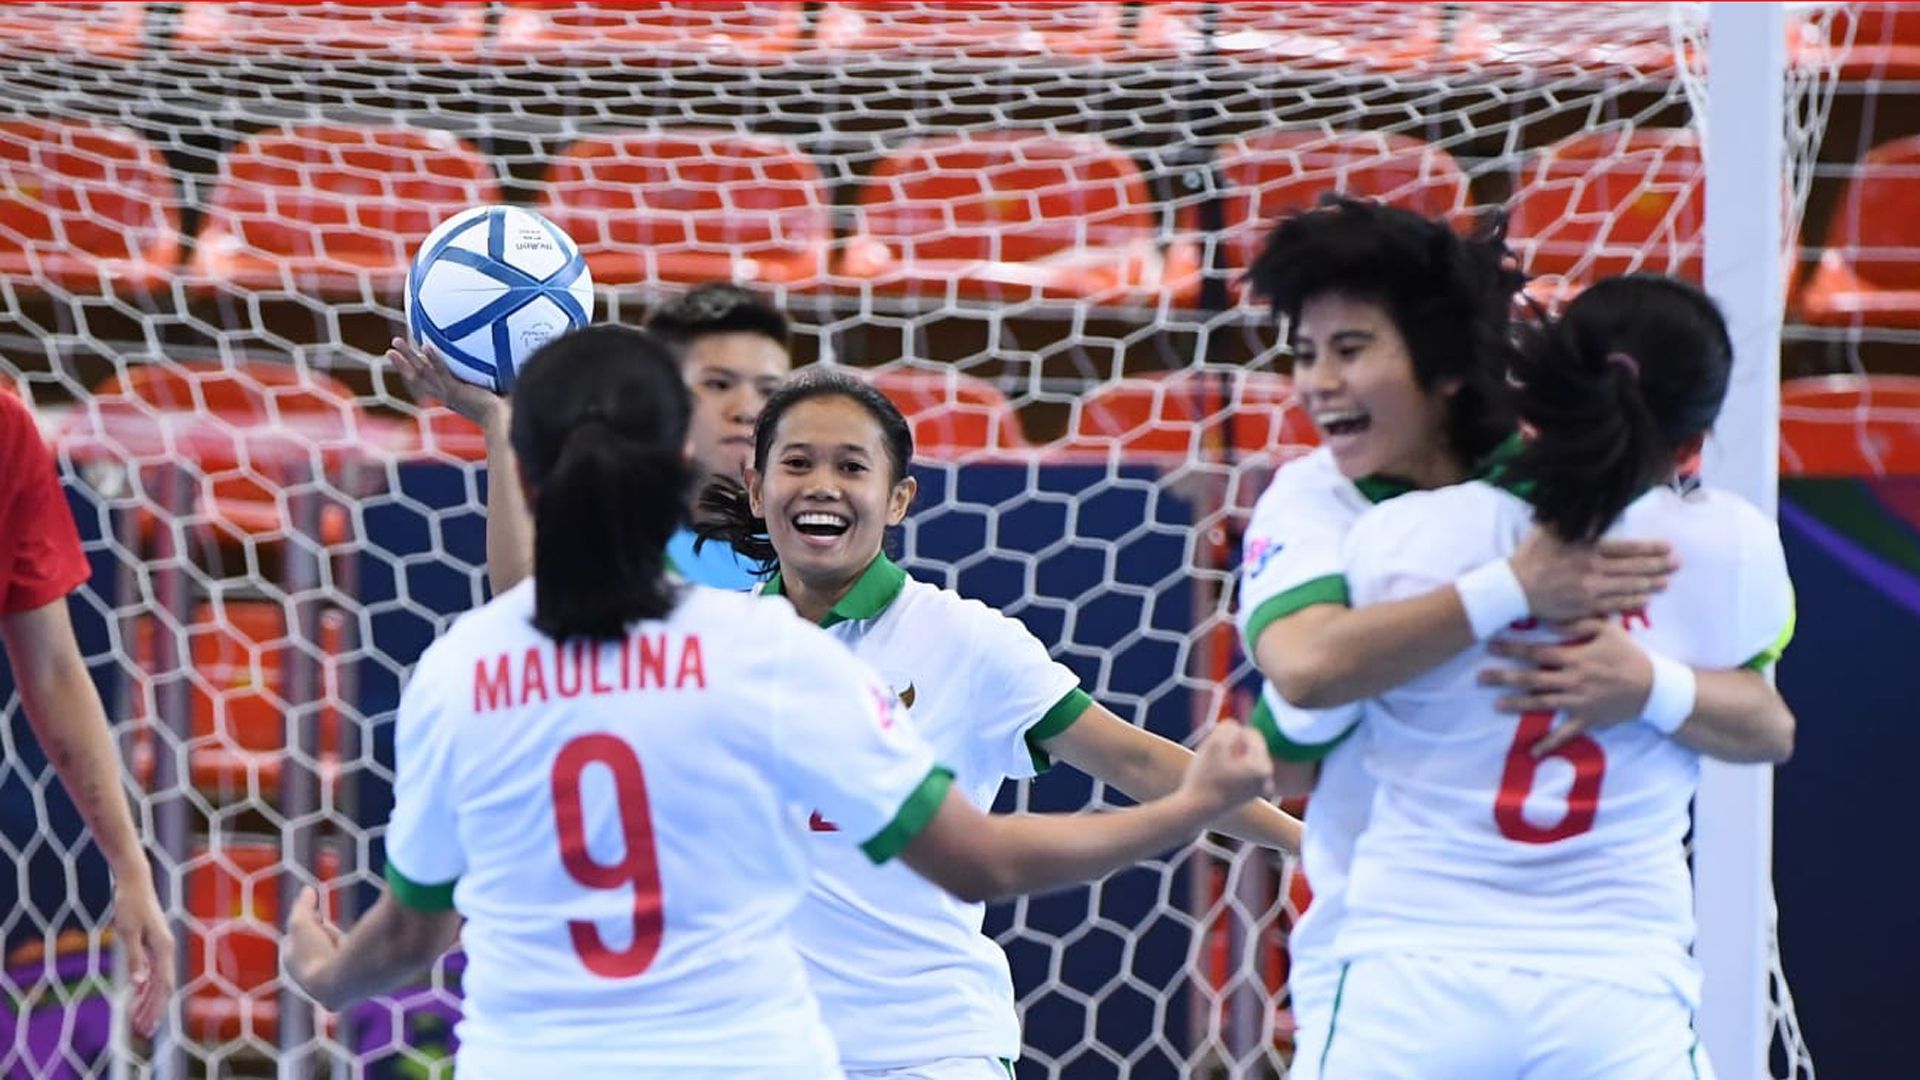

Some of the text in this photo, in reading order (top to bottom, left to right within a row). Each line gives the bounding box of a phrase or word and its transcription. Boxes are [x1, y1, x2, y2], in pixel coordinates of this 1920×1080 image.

[473, 633, 707, 713] MAULINA
[1493, 706, 1607, 845] 6
[551, 732, 664, 979] 9
